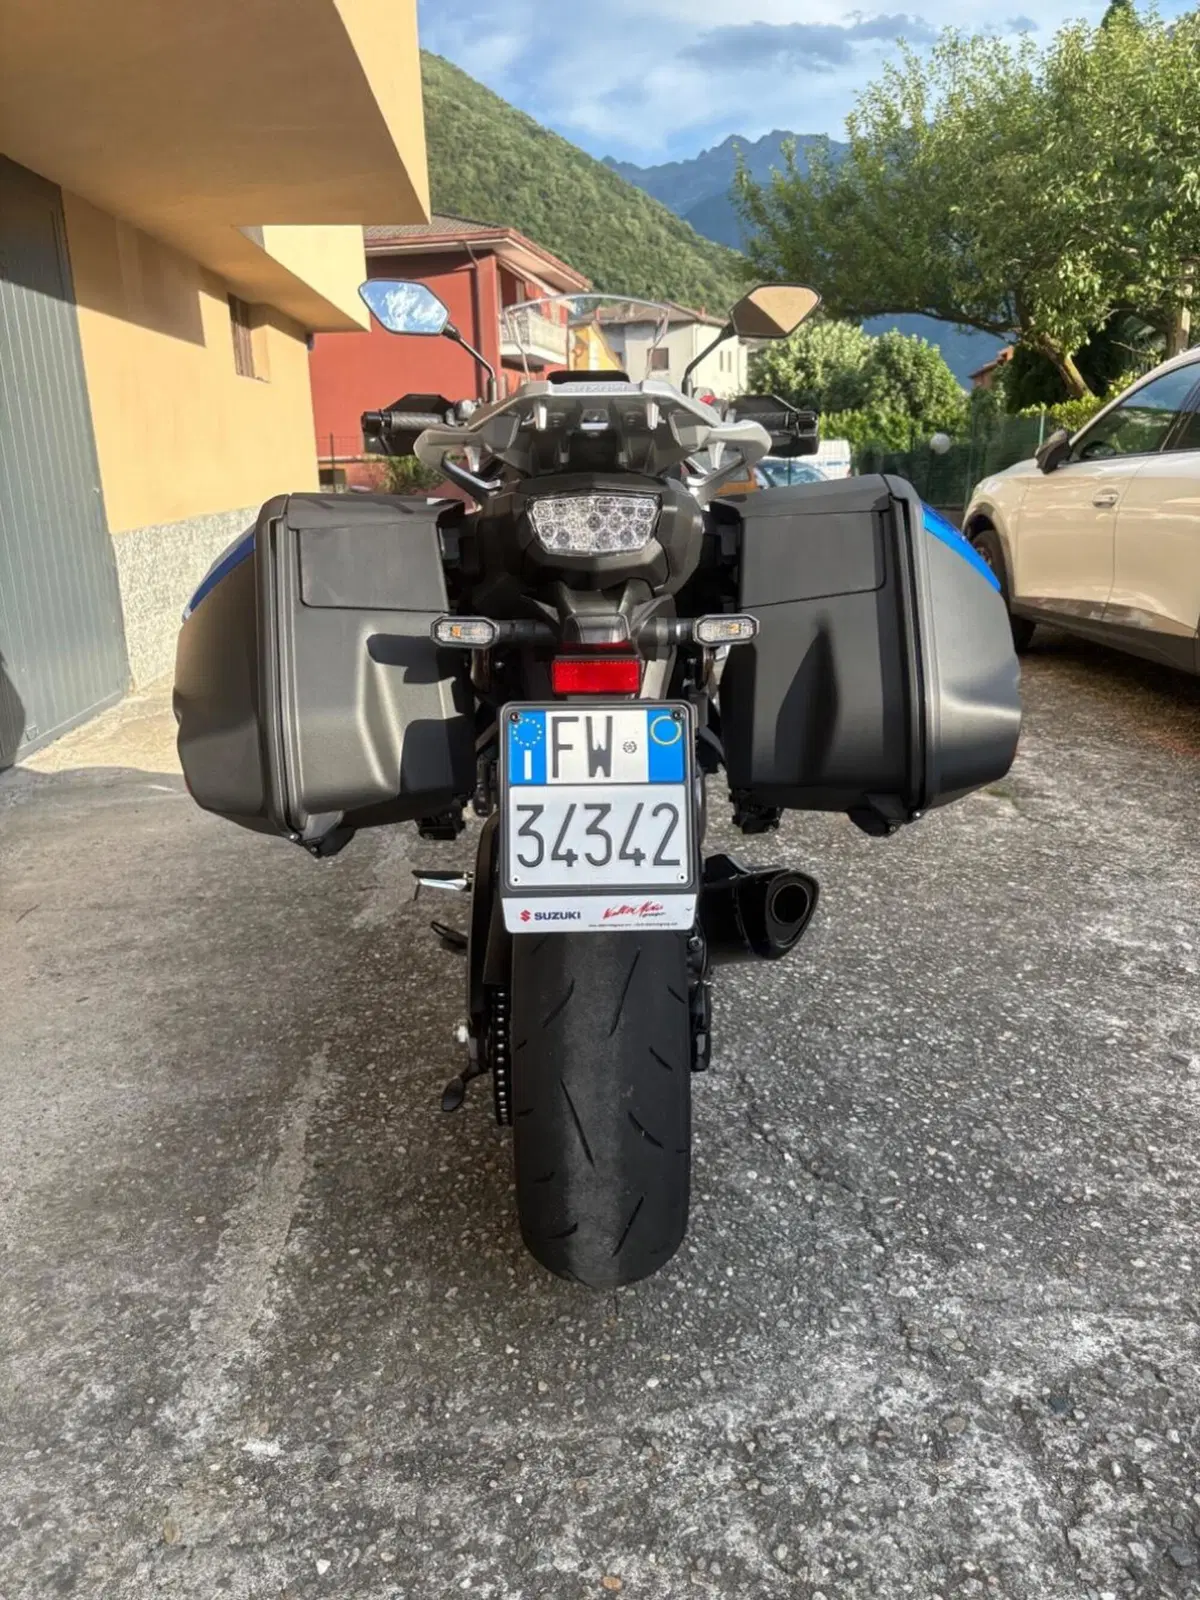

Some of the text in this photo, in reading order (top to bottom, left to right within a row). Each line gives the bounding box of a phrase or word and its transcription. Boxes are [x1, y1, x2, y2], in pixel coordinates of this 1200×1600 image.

[551, 715, 613, 778] FW
[516, 803, 681, 868] 34342
[534, 911, 581, 921] SUZUKI
